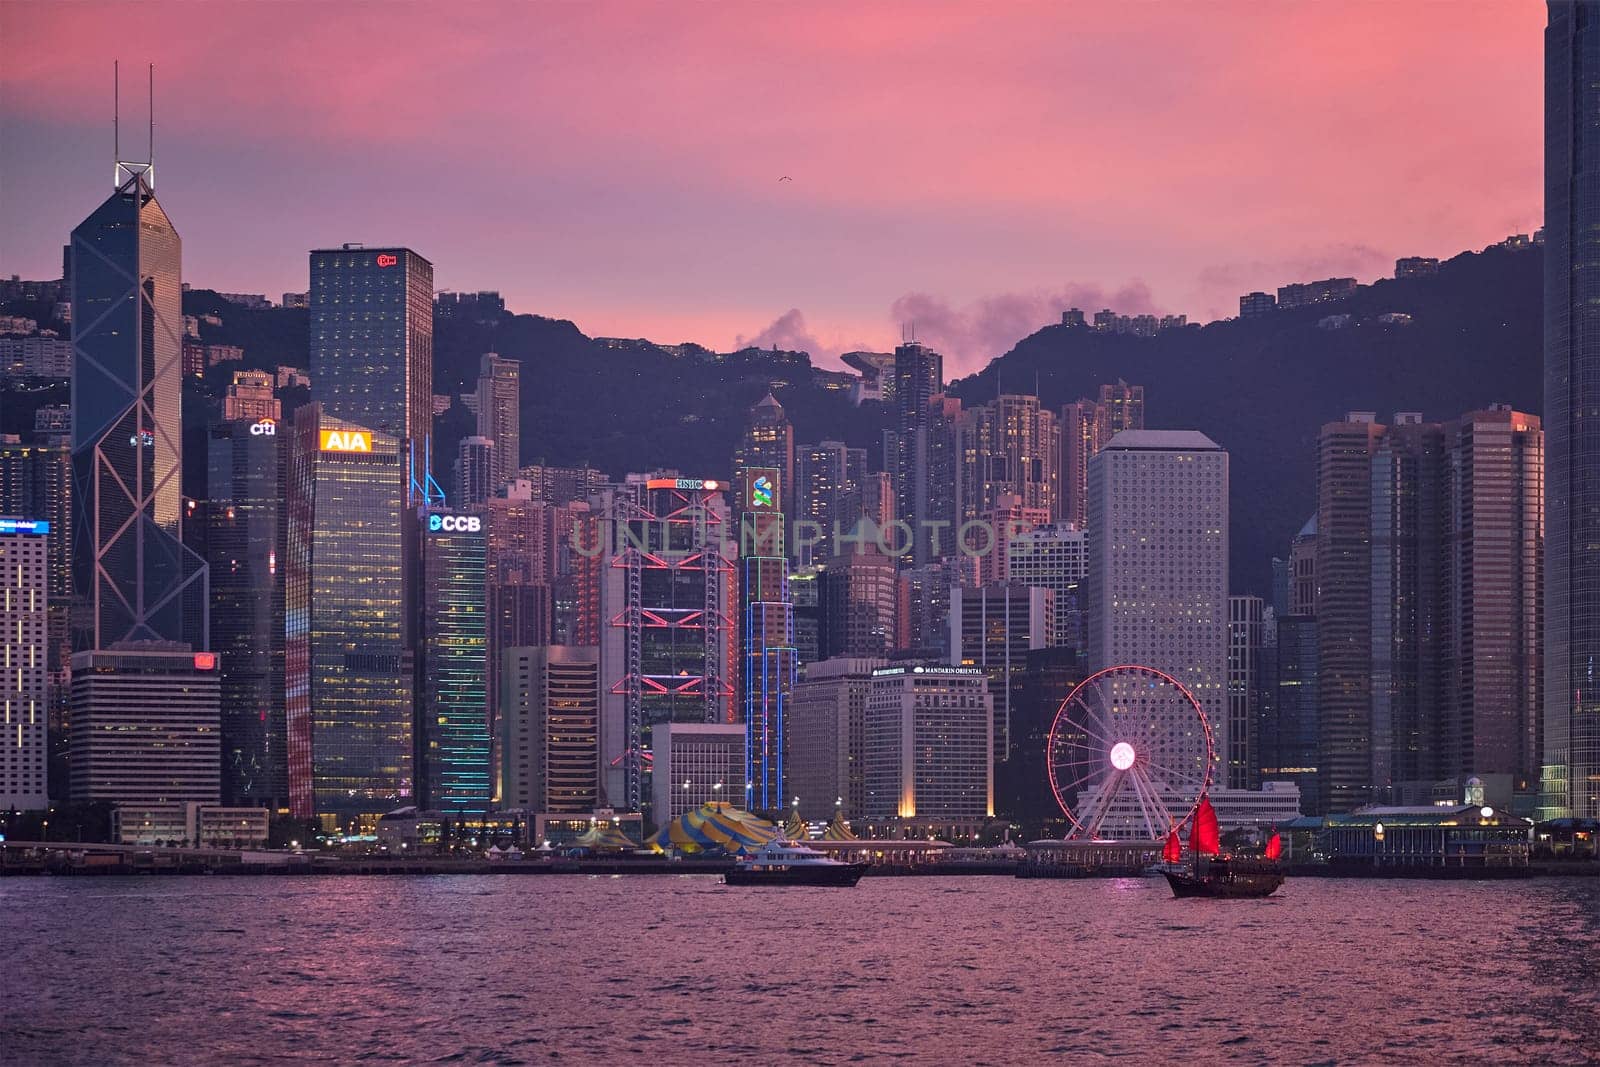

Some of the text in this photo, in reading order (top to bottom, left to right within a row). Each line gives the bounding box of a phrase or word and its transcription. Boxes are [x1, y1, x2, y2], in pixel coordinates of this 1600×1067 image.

[250, 419, 276, 436] citi
[326, 431, 368, 451] AIA
[442, 515, 481, 532] CCB
[925, 666, 955, 674] MANDARIN
